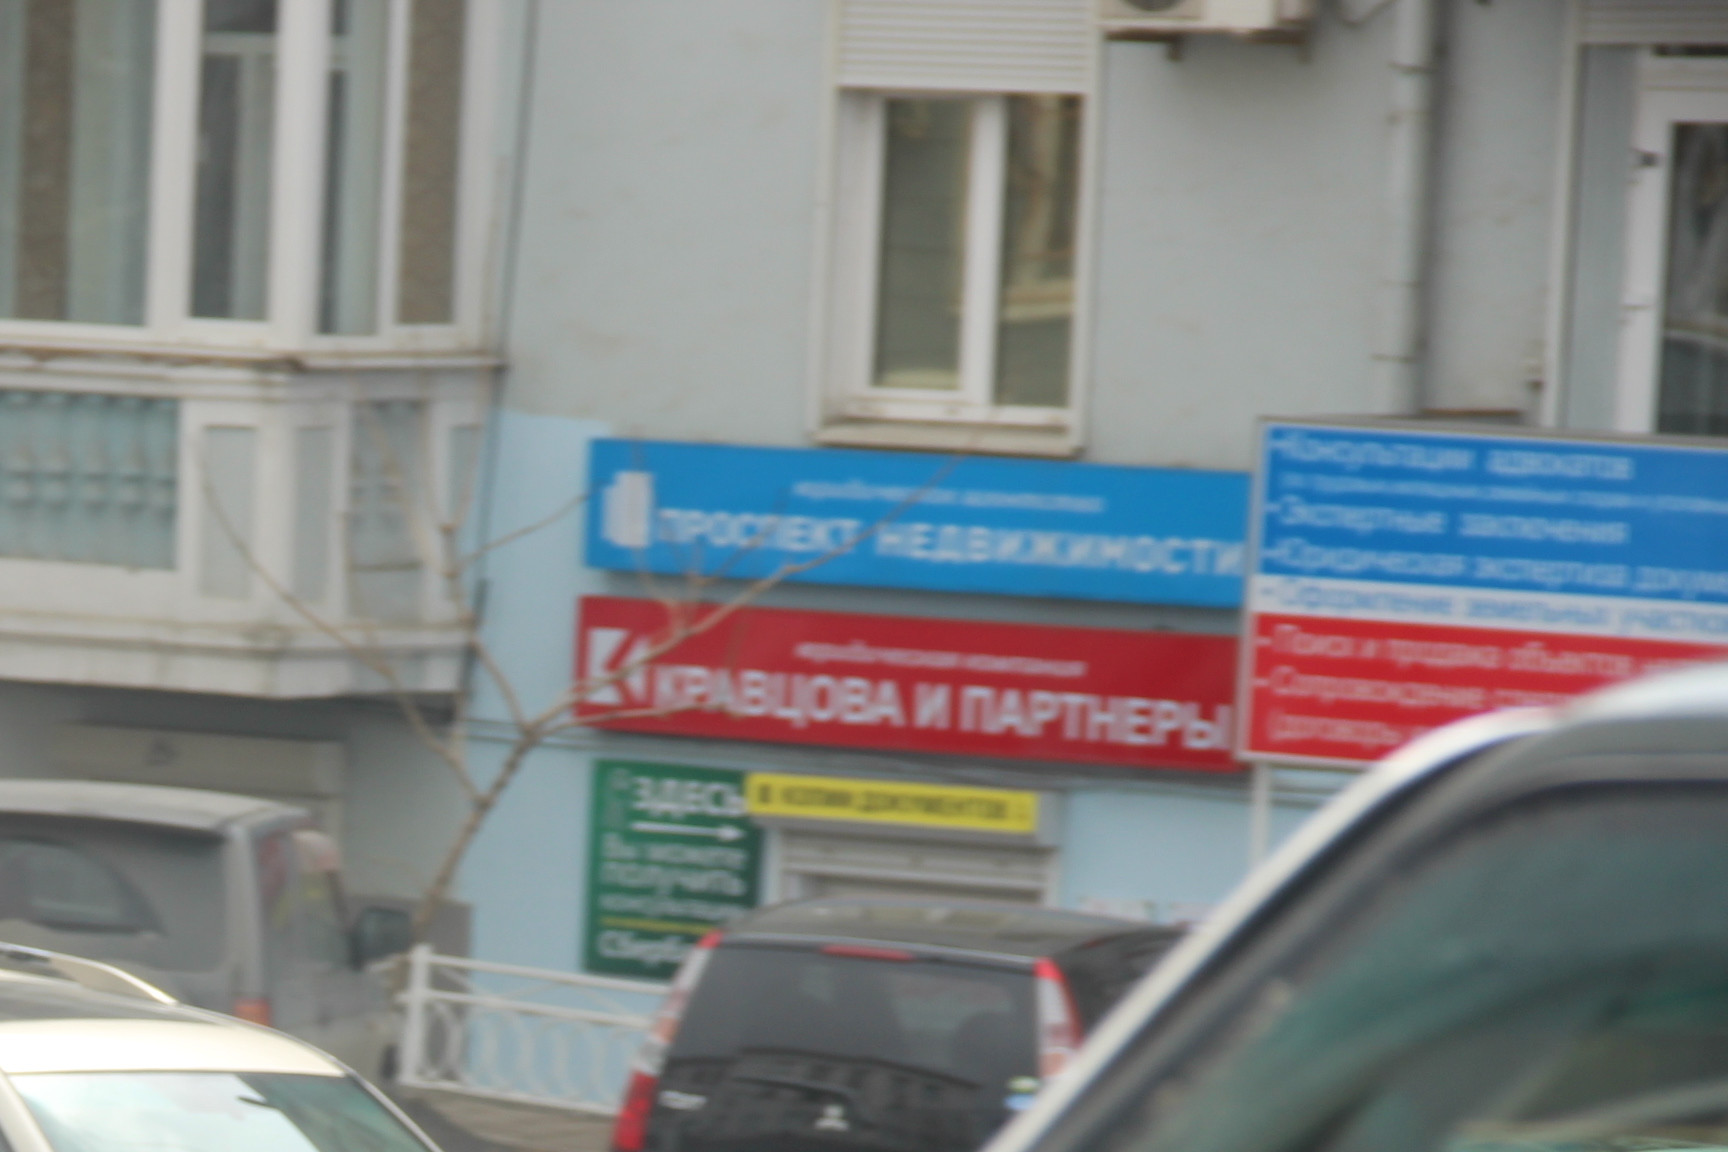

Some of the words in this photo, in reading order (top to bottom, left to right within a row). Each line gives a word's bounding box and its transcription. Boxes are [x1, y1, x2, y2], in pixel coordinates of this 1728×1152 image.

[657, 508, 863, 553] ПРОСПЕКТ
[876, 521, 1246, 577] НЕДВИЖИМОСТИ
[654, 665, 904, 730] КРАВЦОВА
[914, 682, 950, 731] И
[959, 684, 1233, 752] ПАРТНЕРЫ
